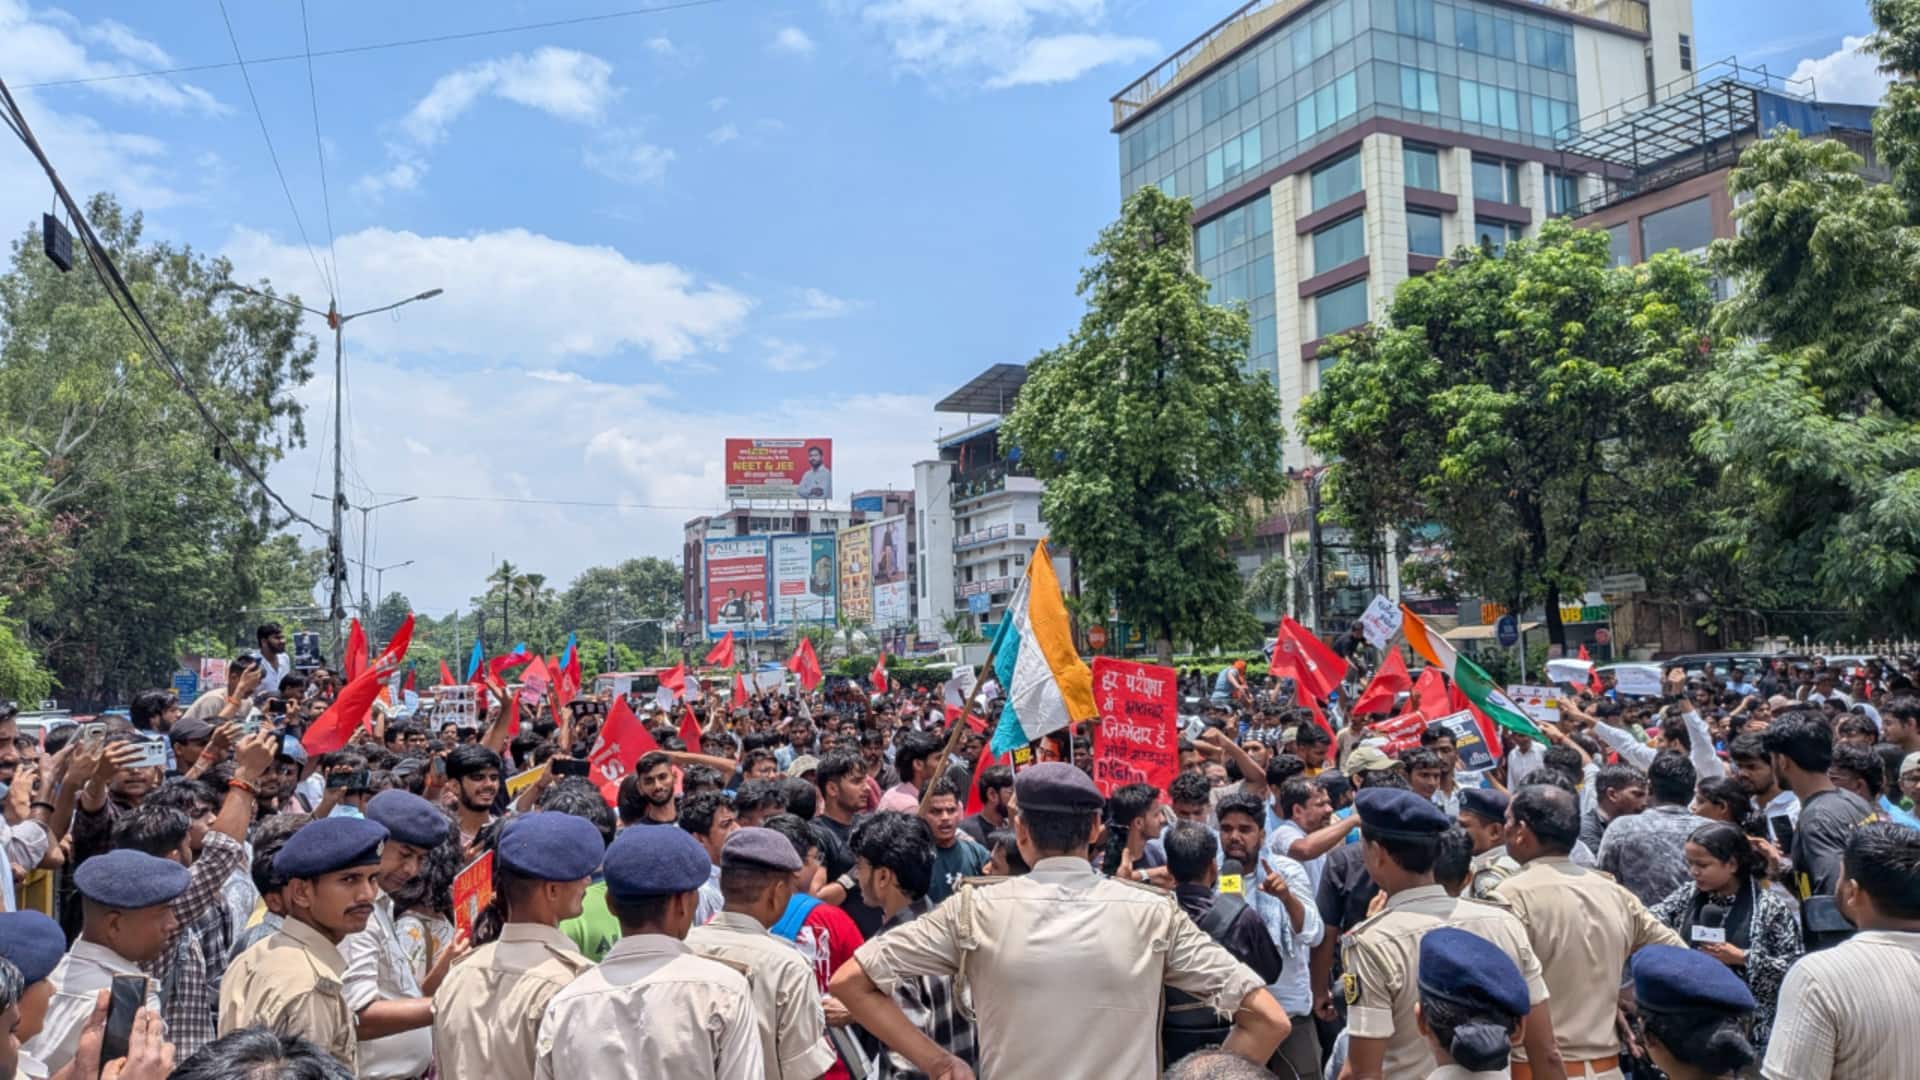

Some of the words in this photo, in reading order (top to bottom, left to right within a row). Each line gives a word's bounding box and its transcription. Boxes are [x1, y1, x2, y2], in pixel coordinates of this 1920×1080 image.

[733, 461, 762, 471] NEET
[764, 461, 773, 471] &
[775, 461, 794, 471] JEE
